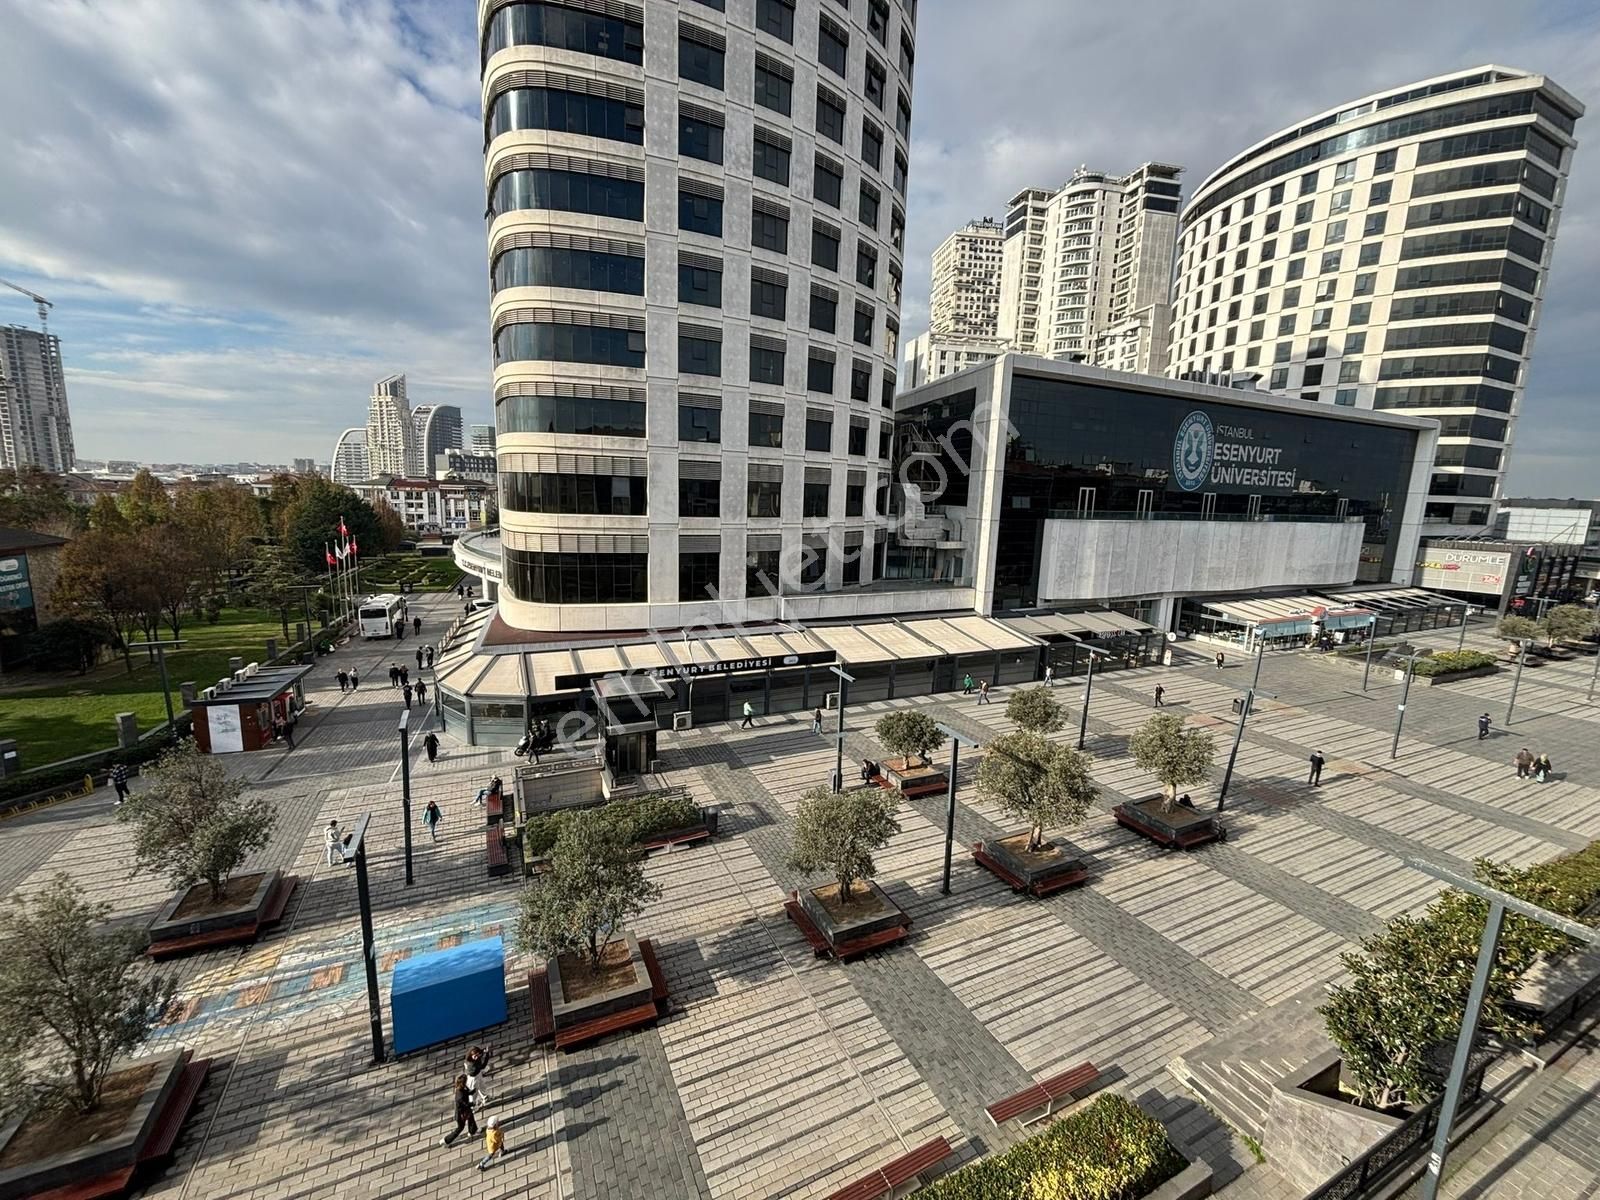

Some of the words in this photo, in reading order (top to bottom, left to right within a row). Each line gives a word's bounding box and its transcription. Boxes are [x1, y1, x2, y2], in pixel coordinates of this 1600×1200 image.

[1216, 422, 1255, 440] İSTANBUL
[1213, 442, 1282, 464] ESENYURT
[1211, 462, 1297, 488] ÜNİVERSİTESİ
[708, 658, 773, 672] BELEDİYESİ
